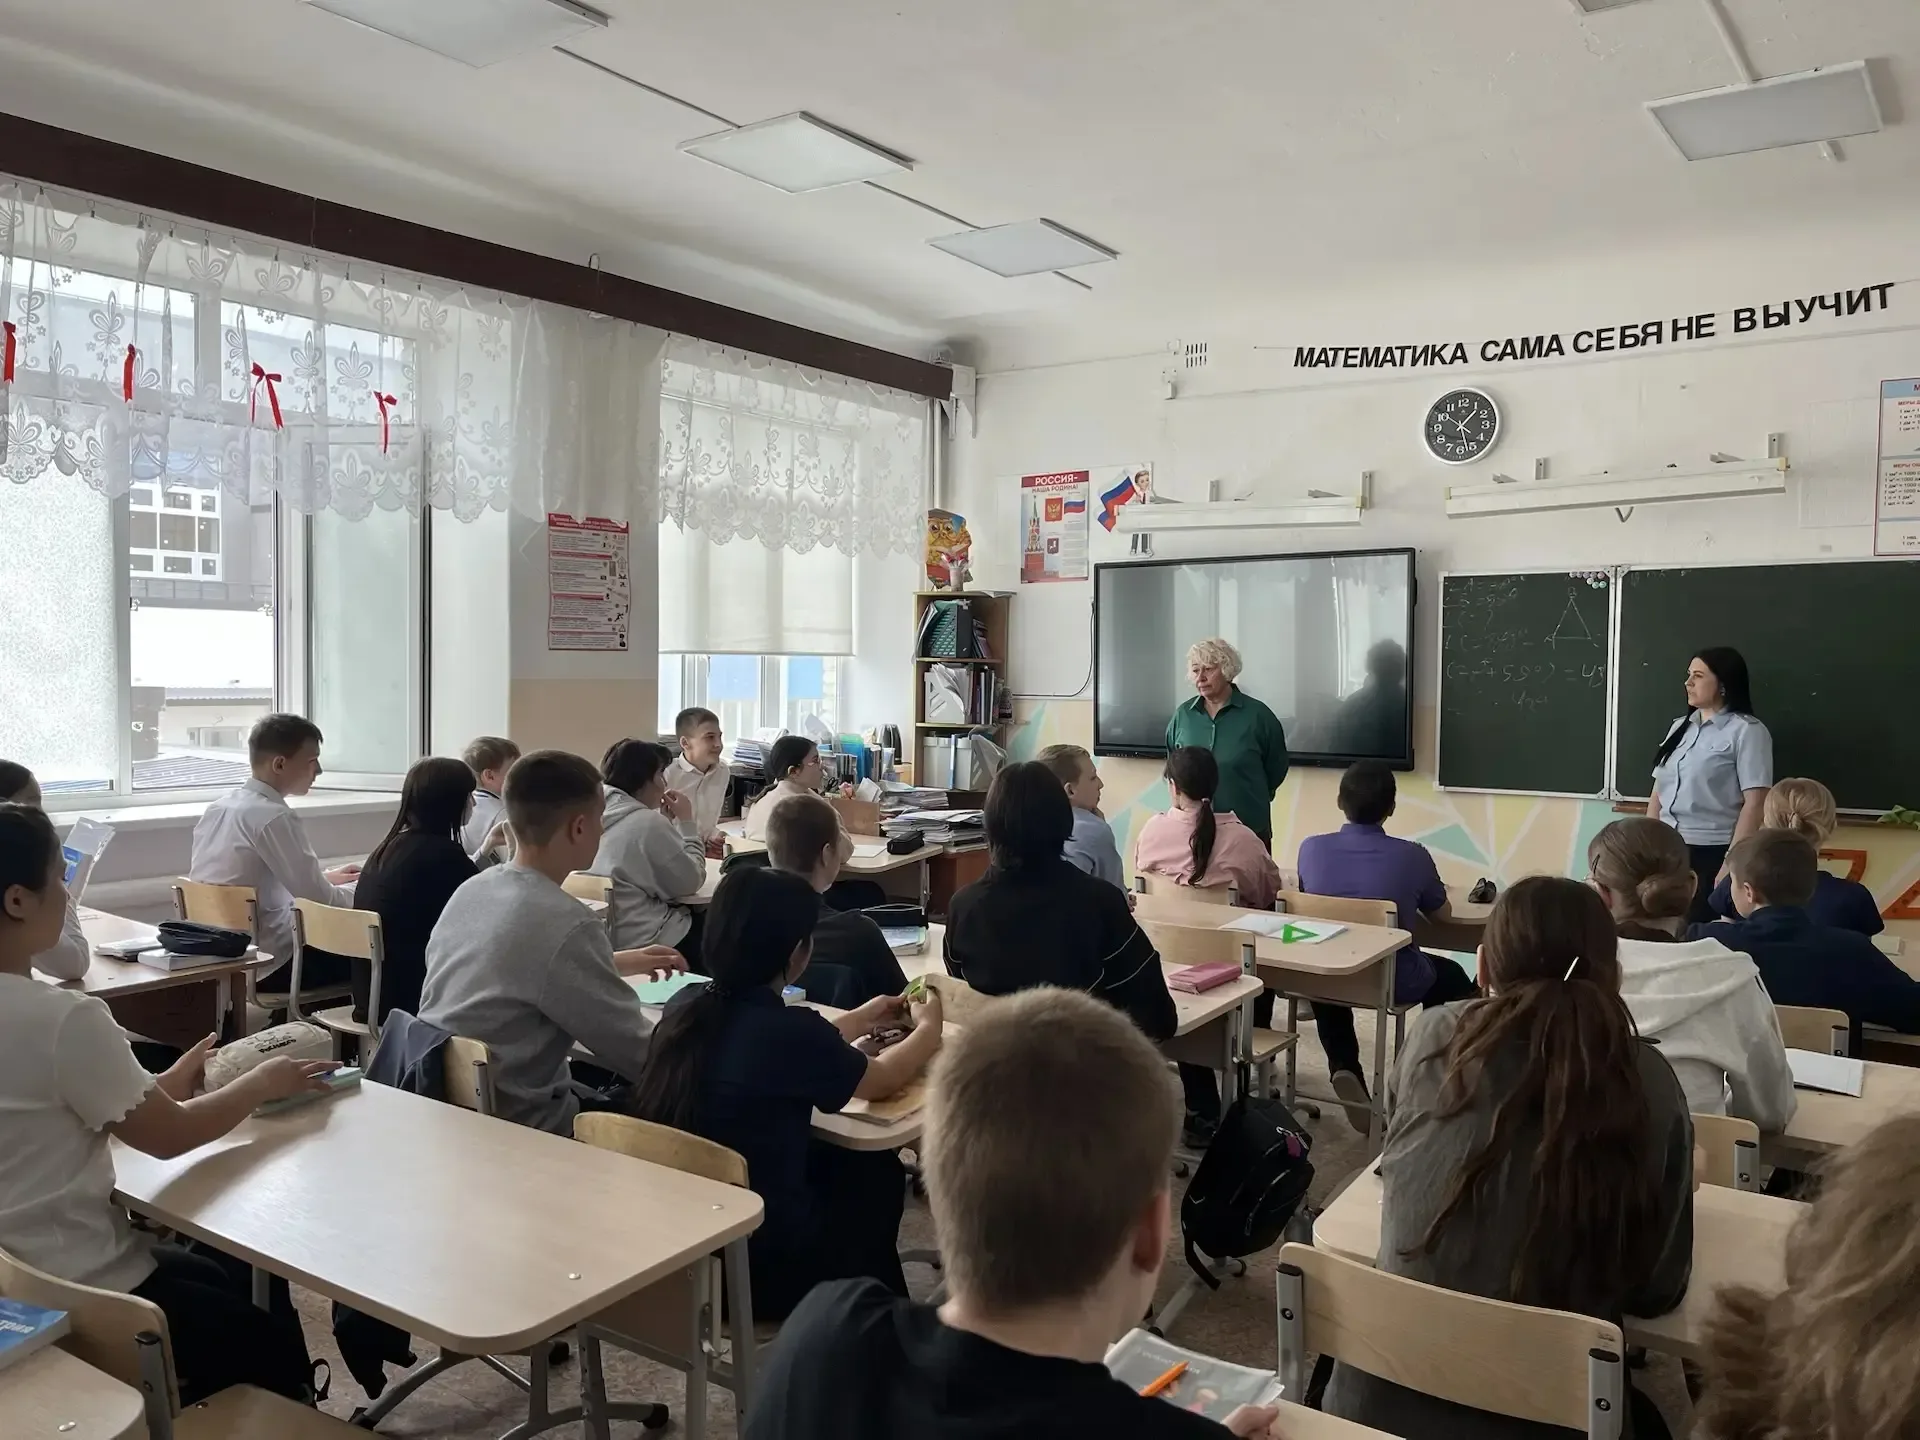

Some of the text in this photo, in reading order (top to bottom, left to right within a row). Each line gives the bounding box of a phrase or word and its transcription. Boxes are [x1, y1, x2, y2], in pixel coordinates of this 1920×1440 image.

[1293, 282, 1895, 368] МАТЕМАТИКА САМА СЕБЯ НЕ ВЫУЧИТ
[1458, 397, 1469, 407] 12
[1474, 401, 1478, 410] 1
[1446, 403, 1455, 413] 11
[1438, 411, 1449, 422] 10
[1479, 409, 1488, 418] 2
[1433, 423, 1442, 433] 9
[1481, 420, 1490, 430] 3
[1436, 434, 1445, 444] 8
[1476, 432, 1484, 441] 4
[1445, 443, 1454, 452] 7
[1456, 445, 1465, 455] 6
[1469, 442, 1477, 451] 5
[1035, 474, 1078, 486] РОССИЯ-
[1032, 486, 1050, 495] НАША
[1051, 484, 1079, 494] РОДИНА!
